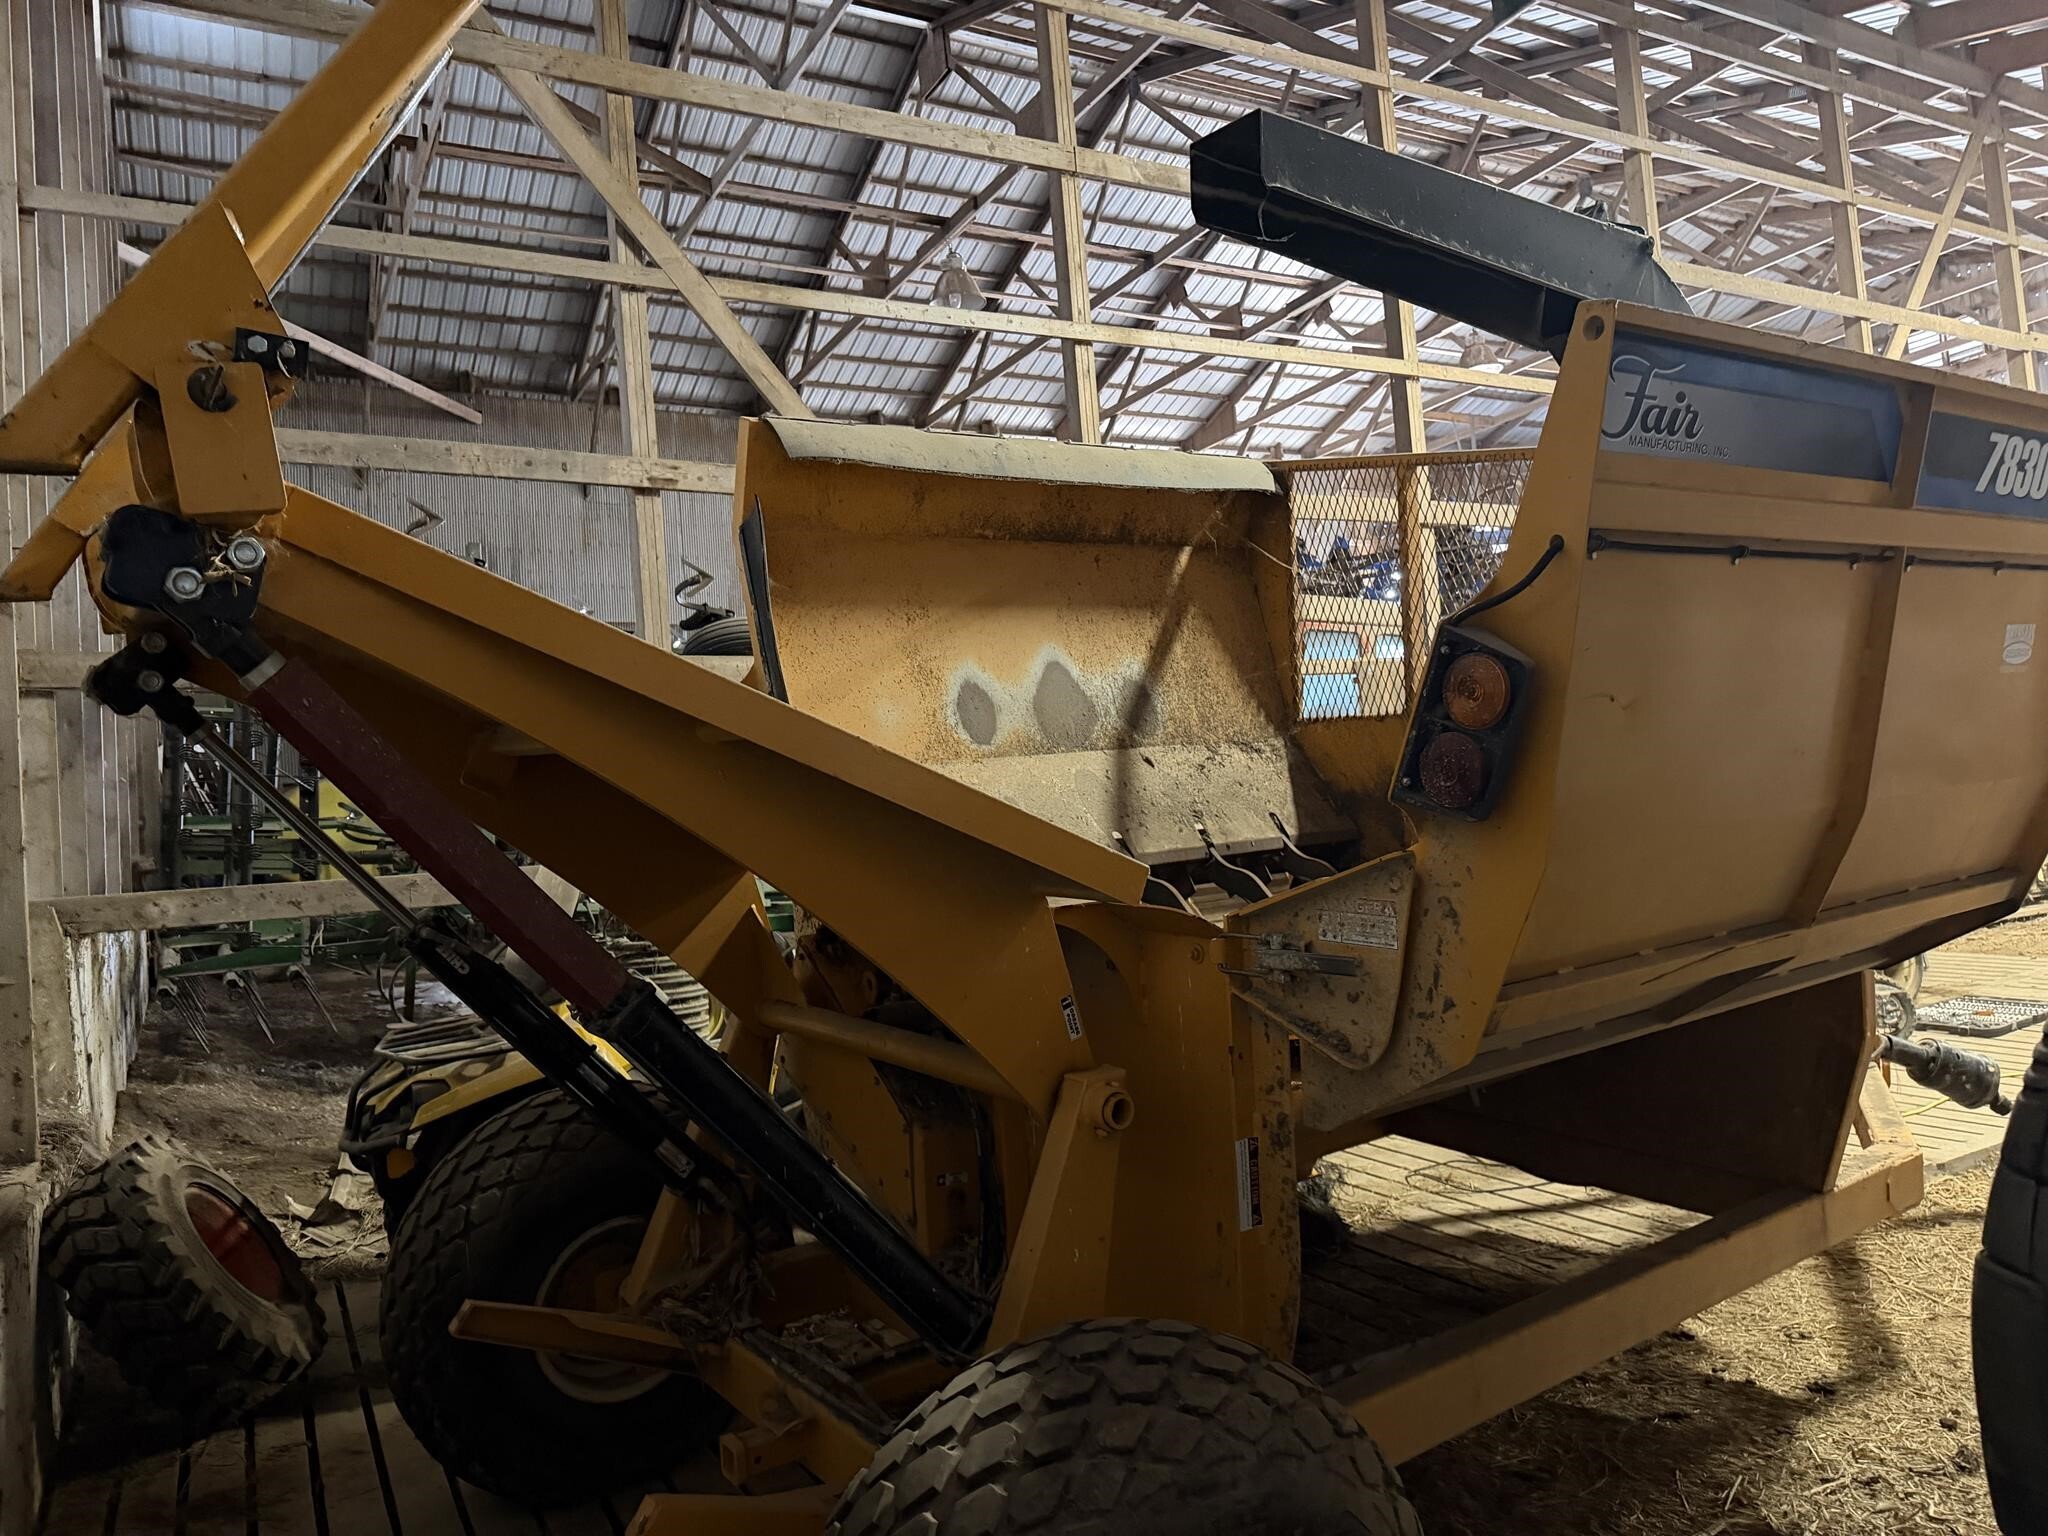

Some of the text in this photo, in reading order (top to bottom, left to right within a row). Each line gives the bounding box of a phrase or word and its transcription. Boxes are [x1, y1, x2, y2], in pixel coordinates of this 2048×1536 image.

[1601, 355, 1704, 441] Fair
[1629, 436, 1710, 456] MANUFACTURING,
[1975, 432, 2048, 500] 7830
[1066, 1013, 1075, 1034] POINT
[1070, 1008, 1080, 1035] GREASE
